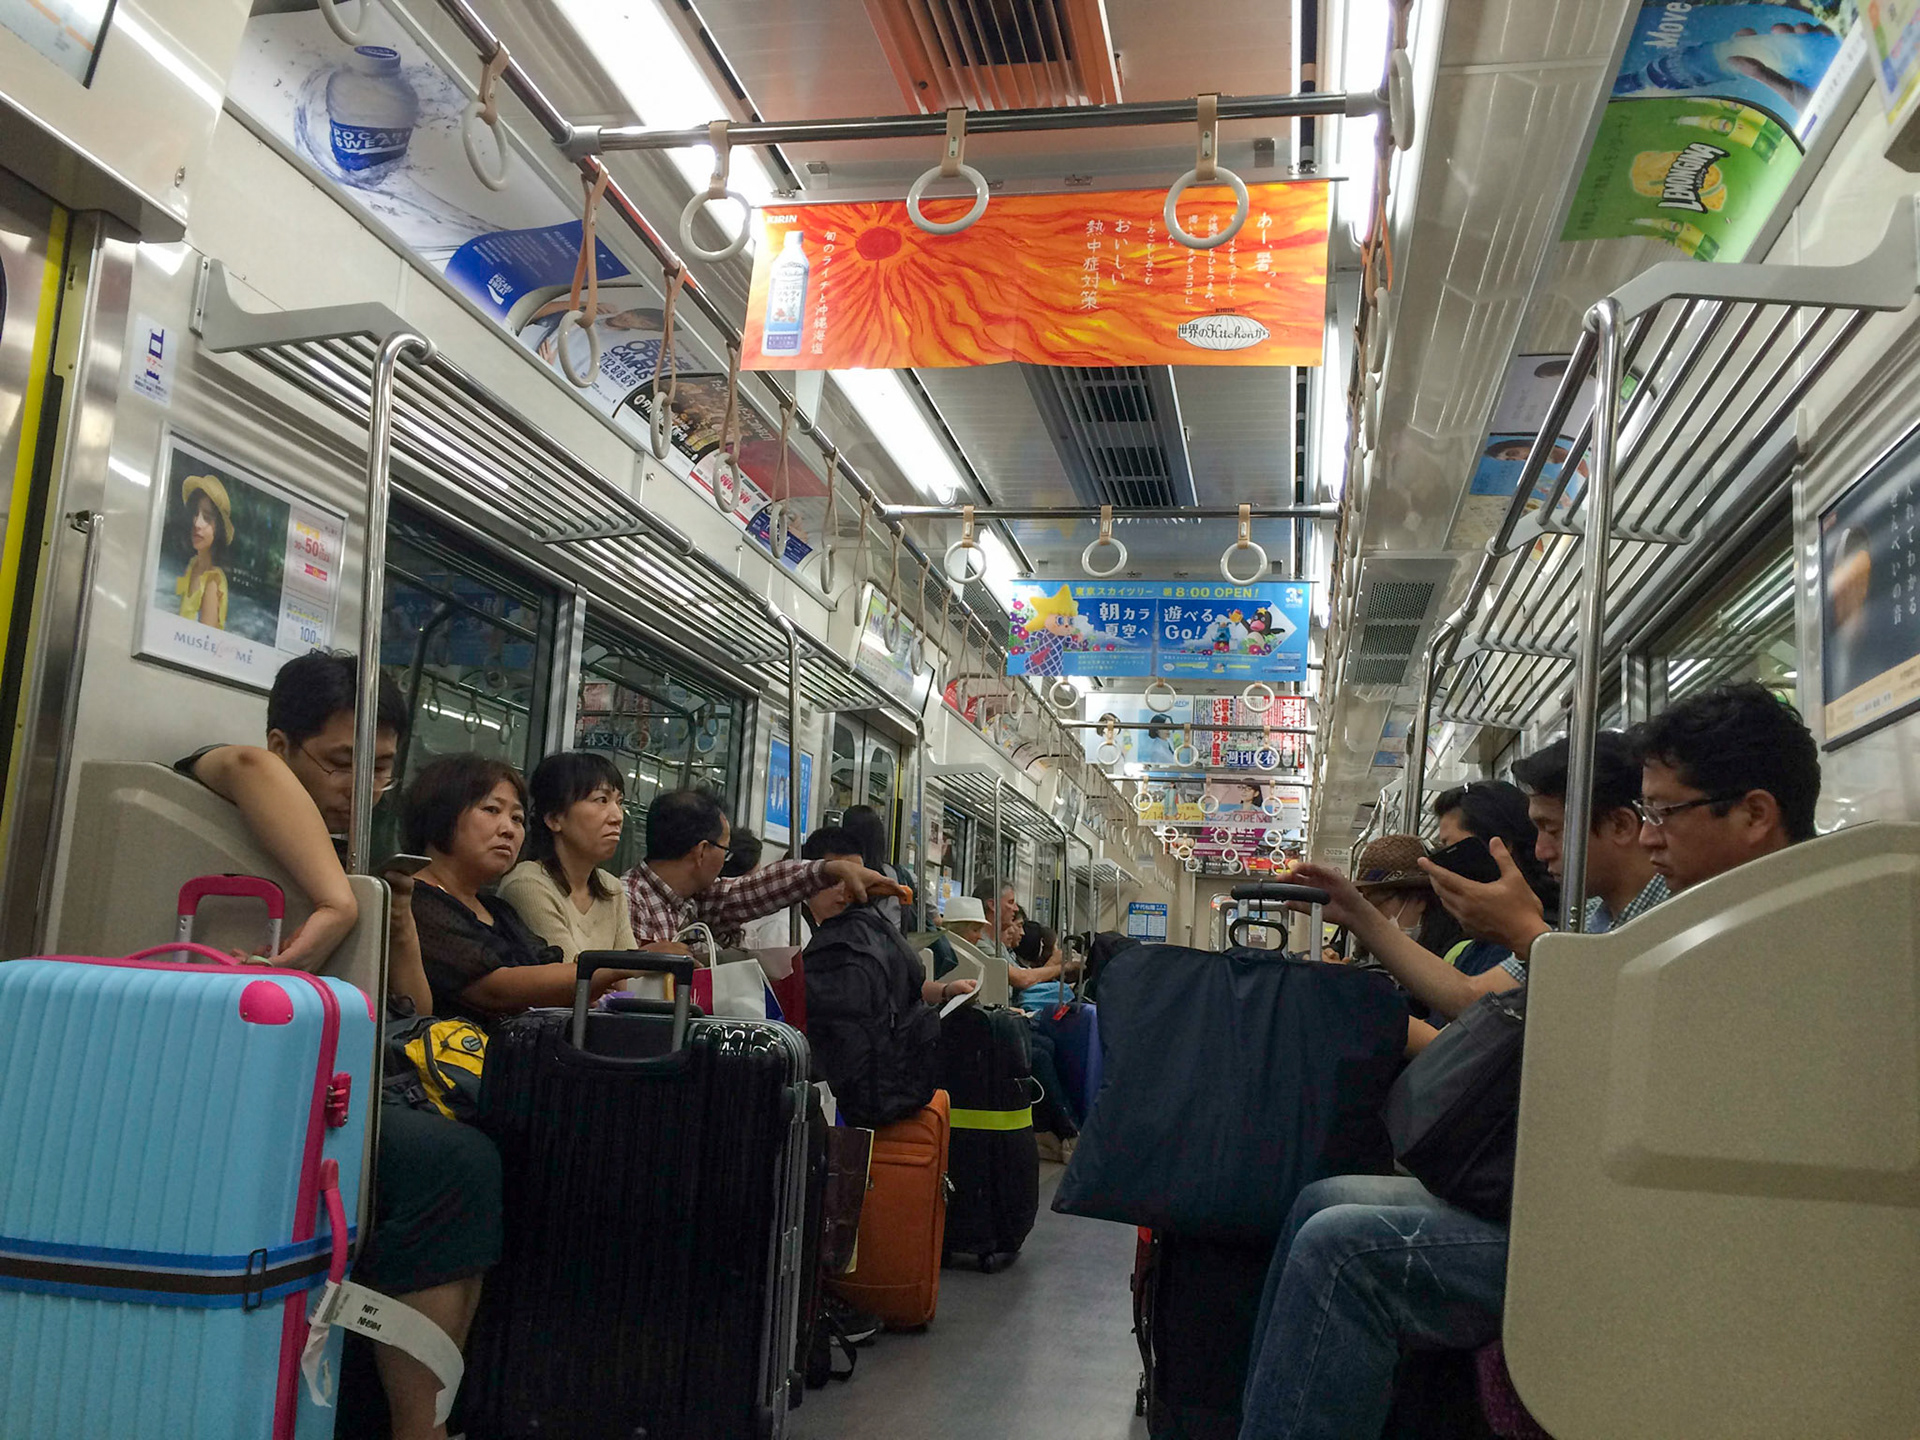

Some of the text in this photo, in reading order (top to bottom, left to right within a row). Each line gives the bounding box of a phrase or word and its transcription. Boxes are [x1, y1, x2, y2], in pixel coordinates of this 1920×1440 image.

[1643, 2, 1692, 49] Move
[1657, 142, 1728, 213] LEMONGINA
[766, 215, 797, 224] KIRIN
[1111, 219, 1132, 287] おいしい
[1080, 220, 1105, 310] 熱中症対策
[488, 279, 510, 296] SWEAT
[492, 273, 514, 294] POCARI
[1075, 587, 1154, 597] 東京スカイツリー
[1175, 587, 1210, 598] 8:00
[1099, 602, 1213, 623] 朝カラ 遊べる
[1105, 623, 1149, 639] 夏空へ
[1165, 624, 1201, 641] Go!
[362, 1304, 379, 1316] NRT
